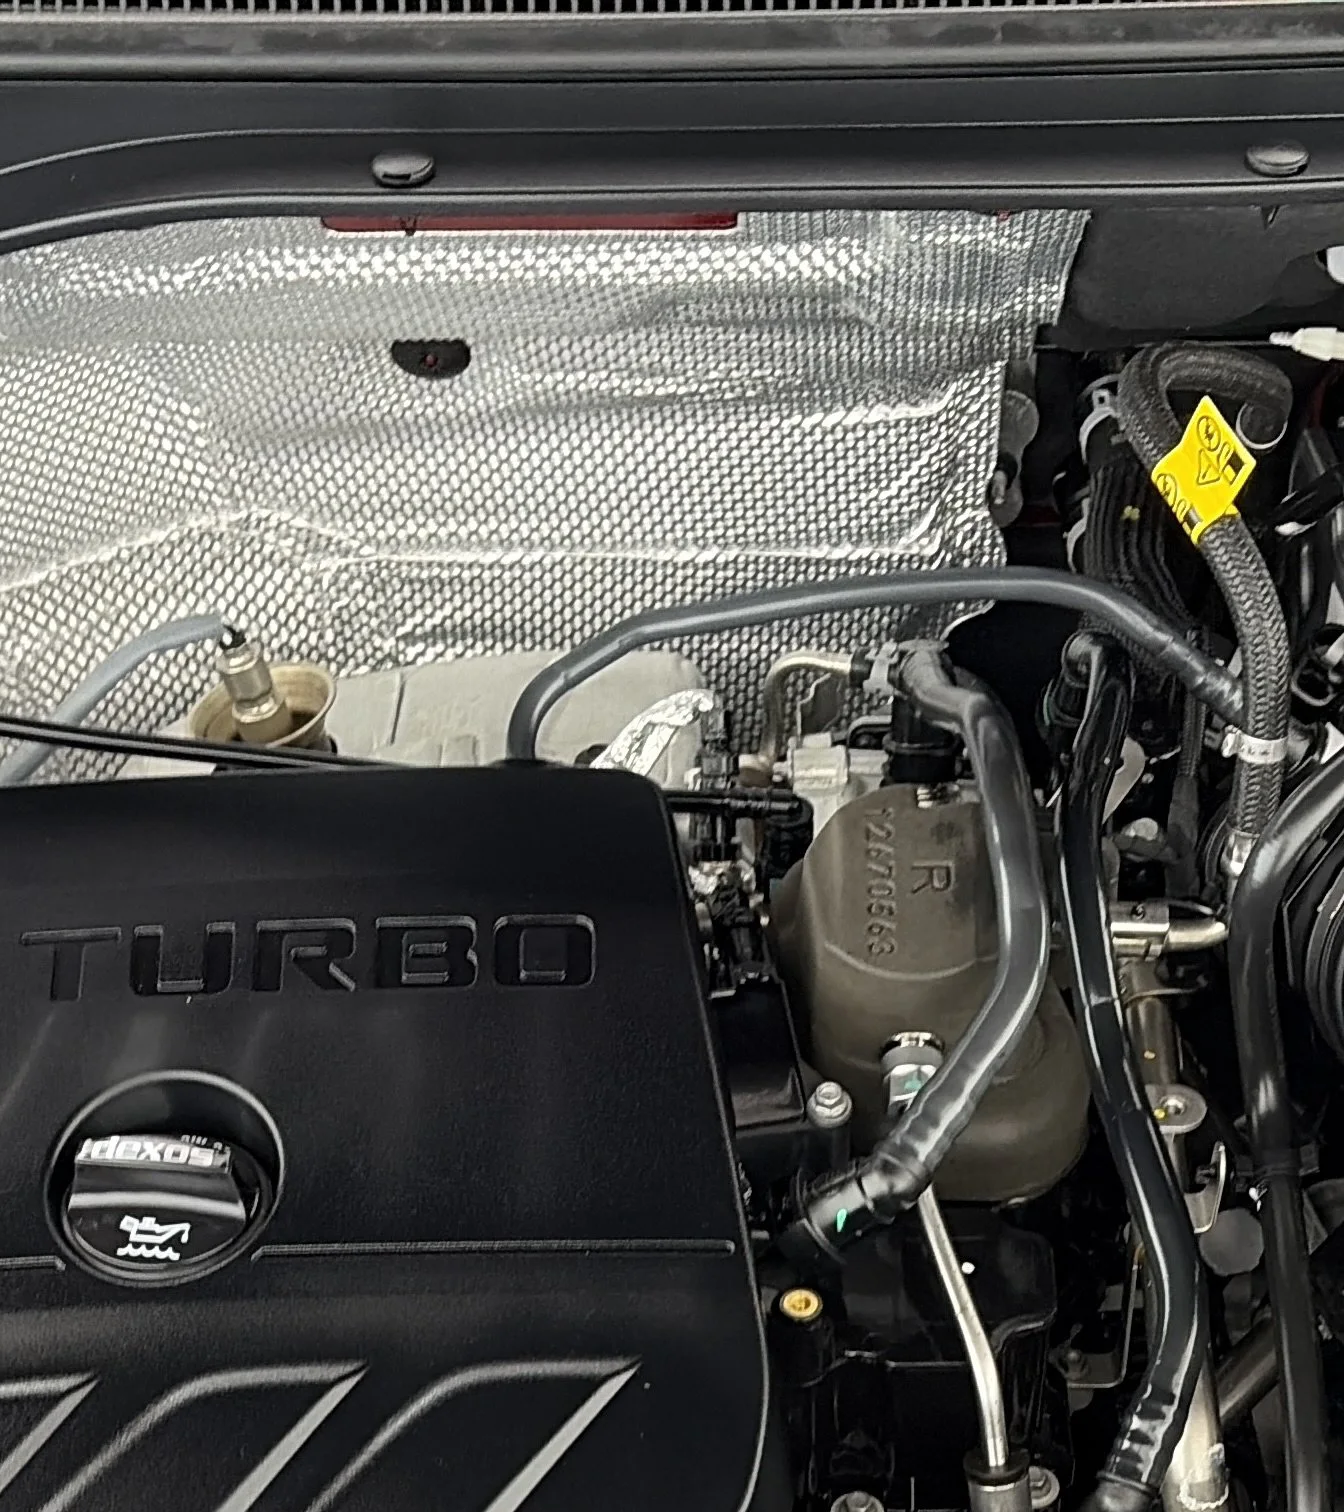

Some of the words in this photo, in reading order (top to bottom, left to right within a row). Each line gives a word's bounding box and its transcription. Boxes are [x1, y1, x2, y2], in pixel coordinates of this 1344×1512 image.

[911, 859, 955, 894] R
[20, 913, 597, 1002] TURBO
[90, 1135, 215, 1168] dexos
